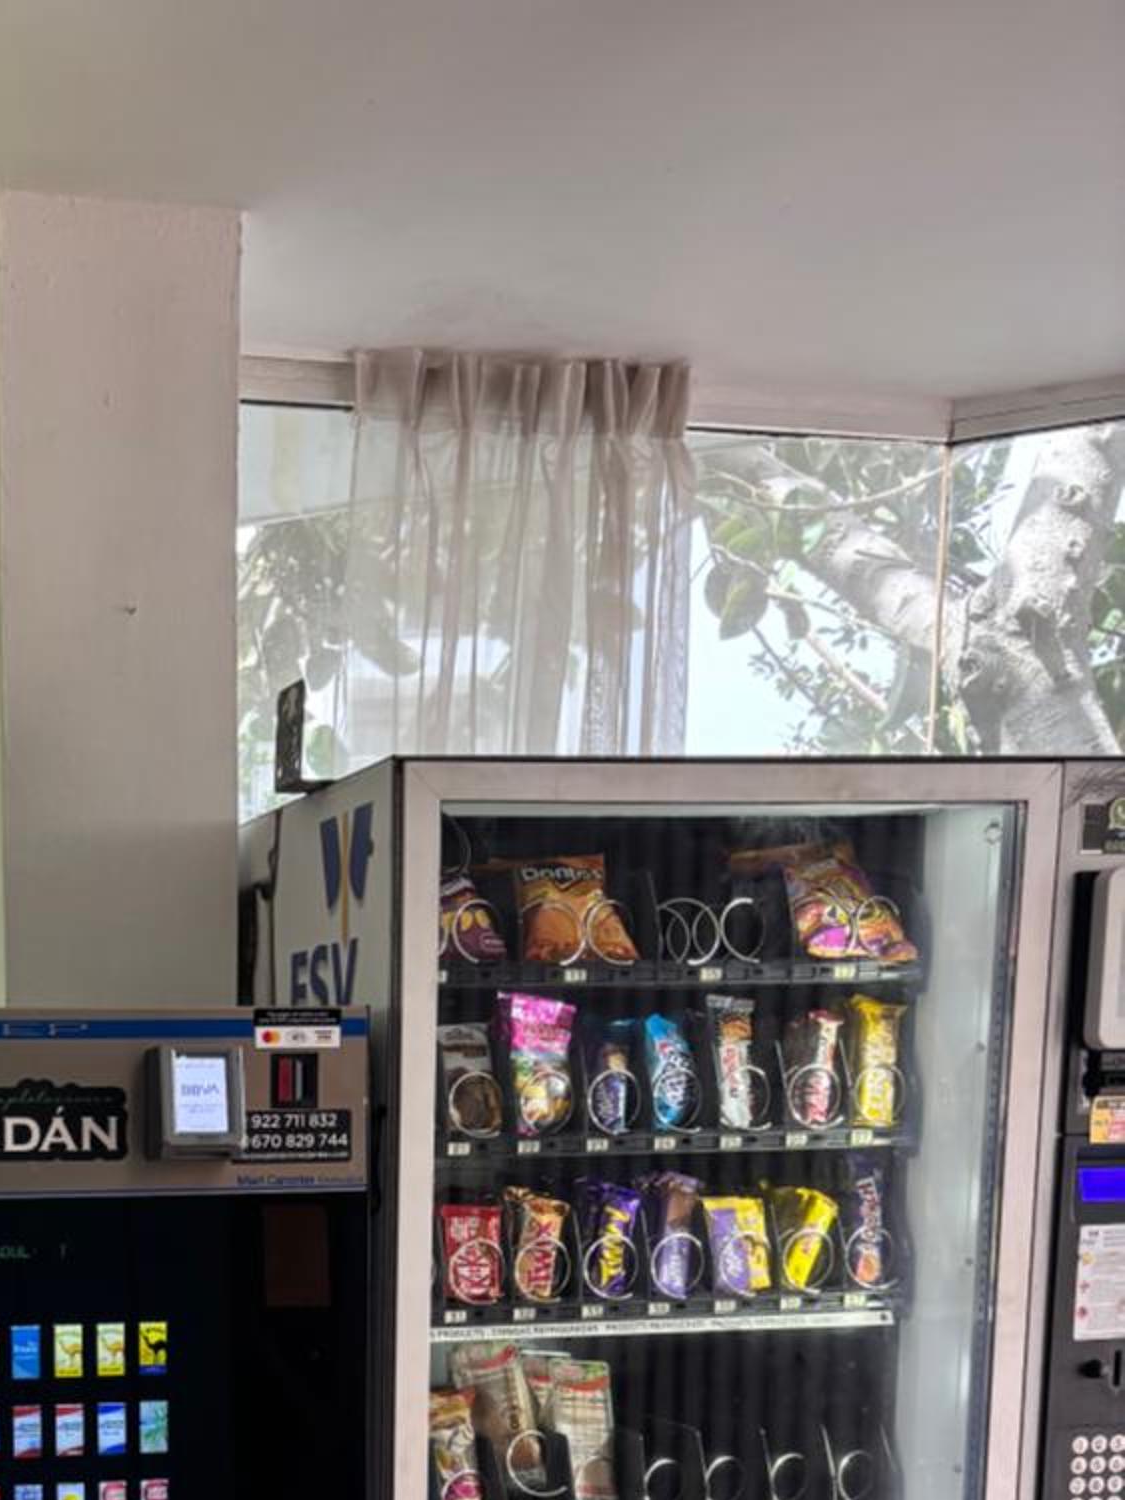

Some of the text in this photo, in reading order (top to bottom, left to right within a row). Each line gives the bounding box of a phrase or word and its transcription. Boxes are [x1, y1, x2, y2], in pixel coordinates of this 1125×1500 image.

[251, 1113, 281, 1129] 922
[284, 1113, 306, 1129] 711
[251, 1133, 348, 1149] 670 829 744
